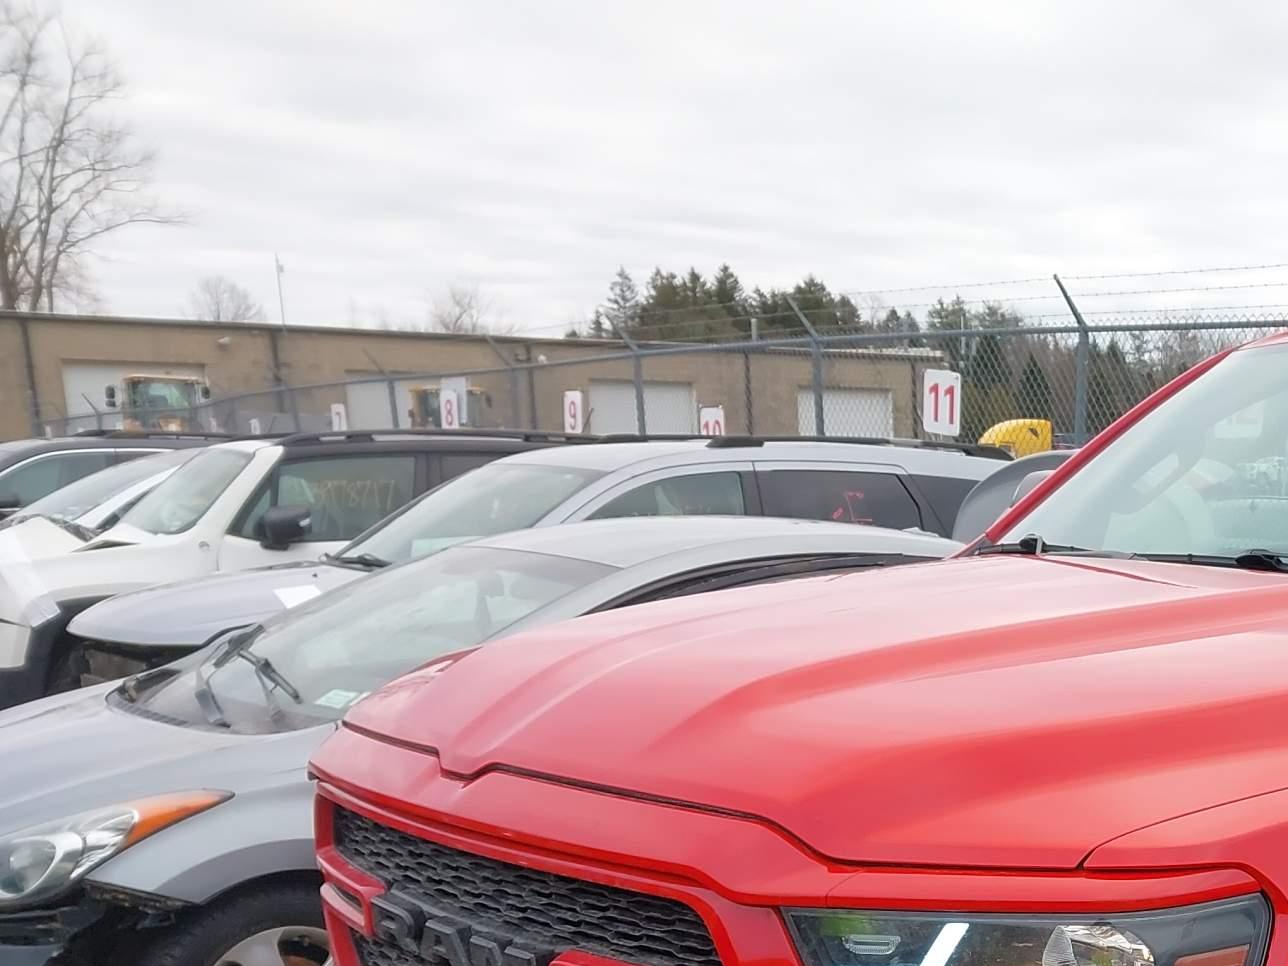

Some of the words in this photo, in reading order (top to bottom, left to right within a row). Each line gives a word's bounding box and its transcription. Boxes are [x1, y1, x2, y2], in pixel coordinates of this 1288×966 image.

[445, 399, 453, 426] 8
[569, 400, 577, 431] 9
[929, 383, 954, 425] 11
